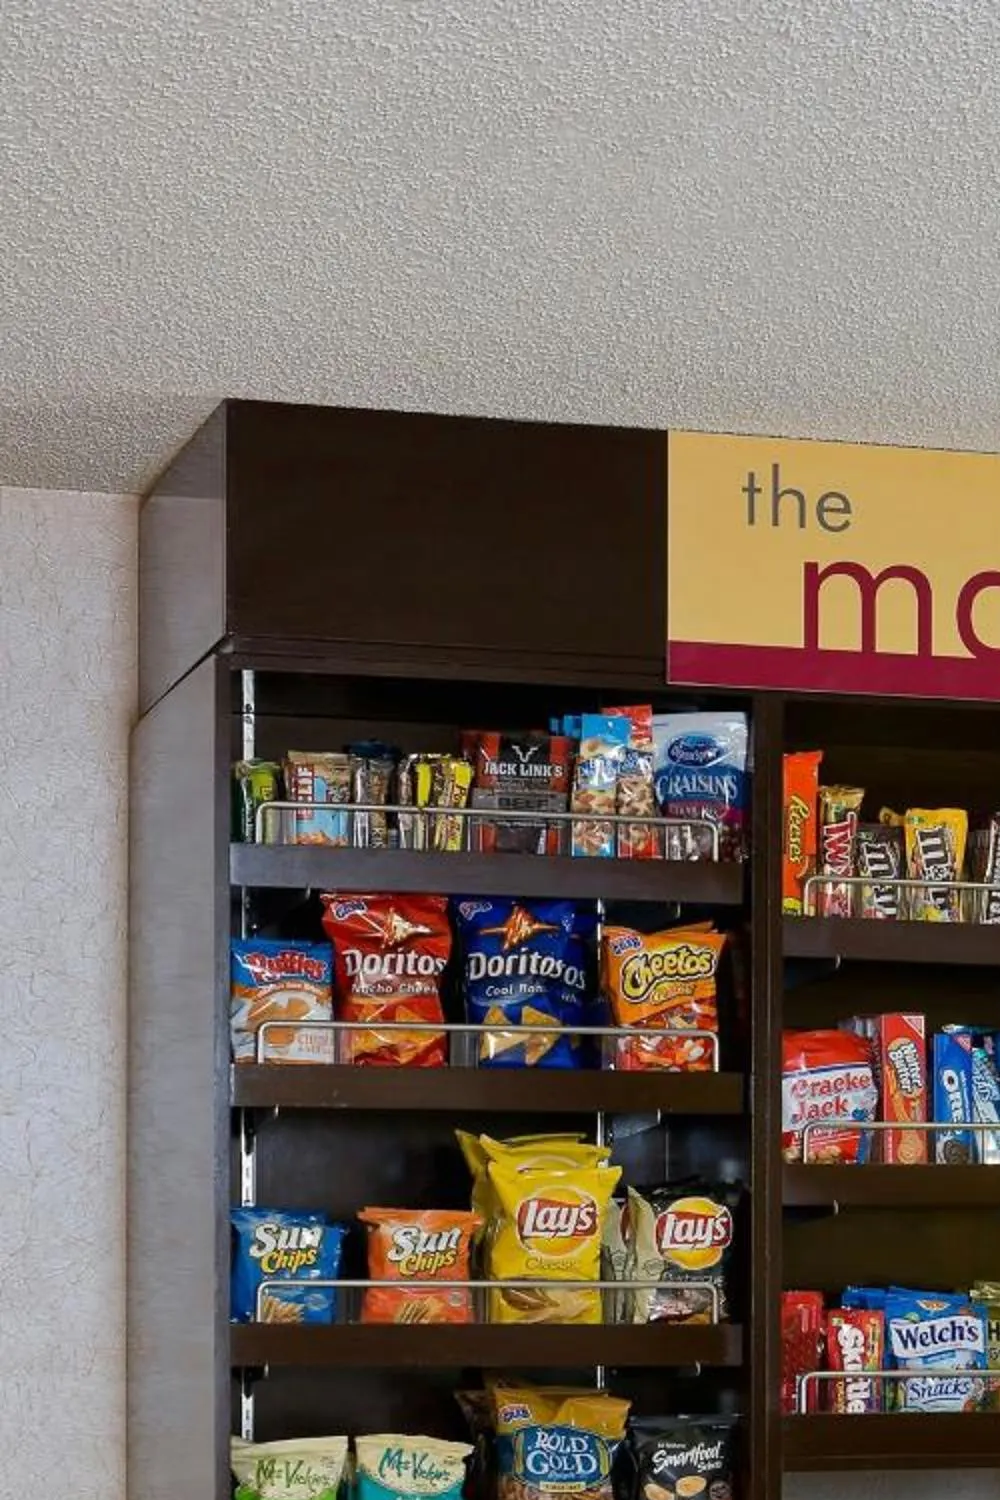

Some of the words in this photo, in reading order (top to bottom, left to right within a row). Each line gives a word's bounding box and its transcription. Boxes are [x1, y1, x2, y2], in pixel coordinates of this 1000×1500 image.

[741, 462, 853, 533] the
[484, 762, 517, 776] JACK
[656, 774, 738, 804] CRAISINS
[341, 947, 448, 977] Doritos
[468, 947, 564, 981] Doritos
[622, 944, 713, 1000] Cheetos
[485, 984, 514, 998] Cool
[791, 1095, 850, 1125] Jack
[522, 1200, 596, 1238] Lay's
[661, 1211, 729, 1250] Lay's
[250, 1223, 323, 1258] Sun
[388, 1226, 461, 1261] Sun
[260, 1249, 317, 1273] Chips
[400, 1251, 456, 1275] Chips
[893, 1321, 979, 1350] Welch's
[535, 1428, 589, 1453] ROLD
[525, 1451, 598, 1475] GOLD
[652, 1440, 723, 1475] Smartfood
